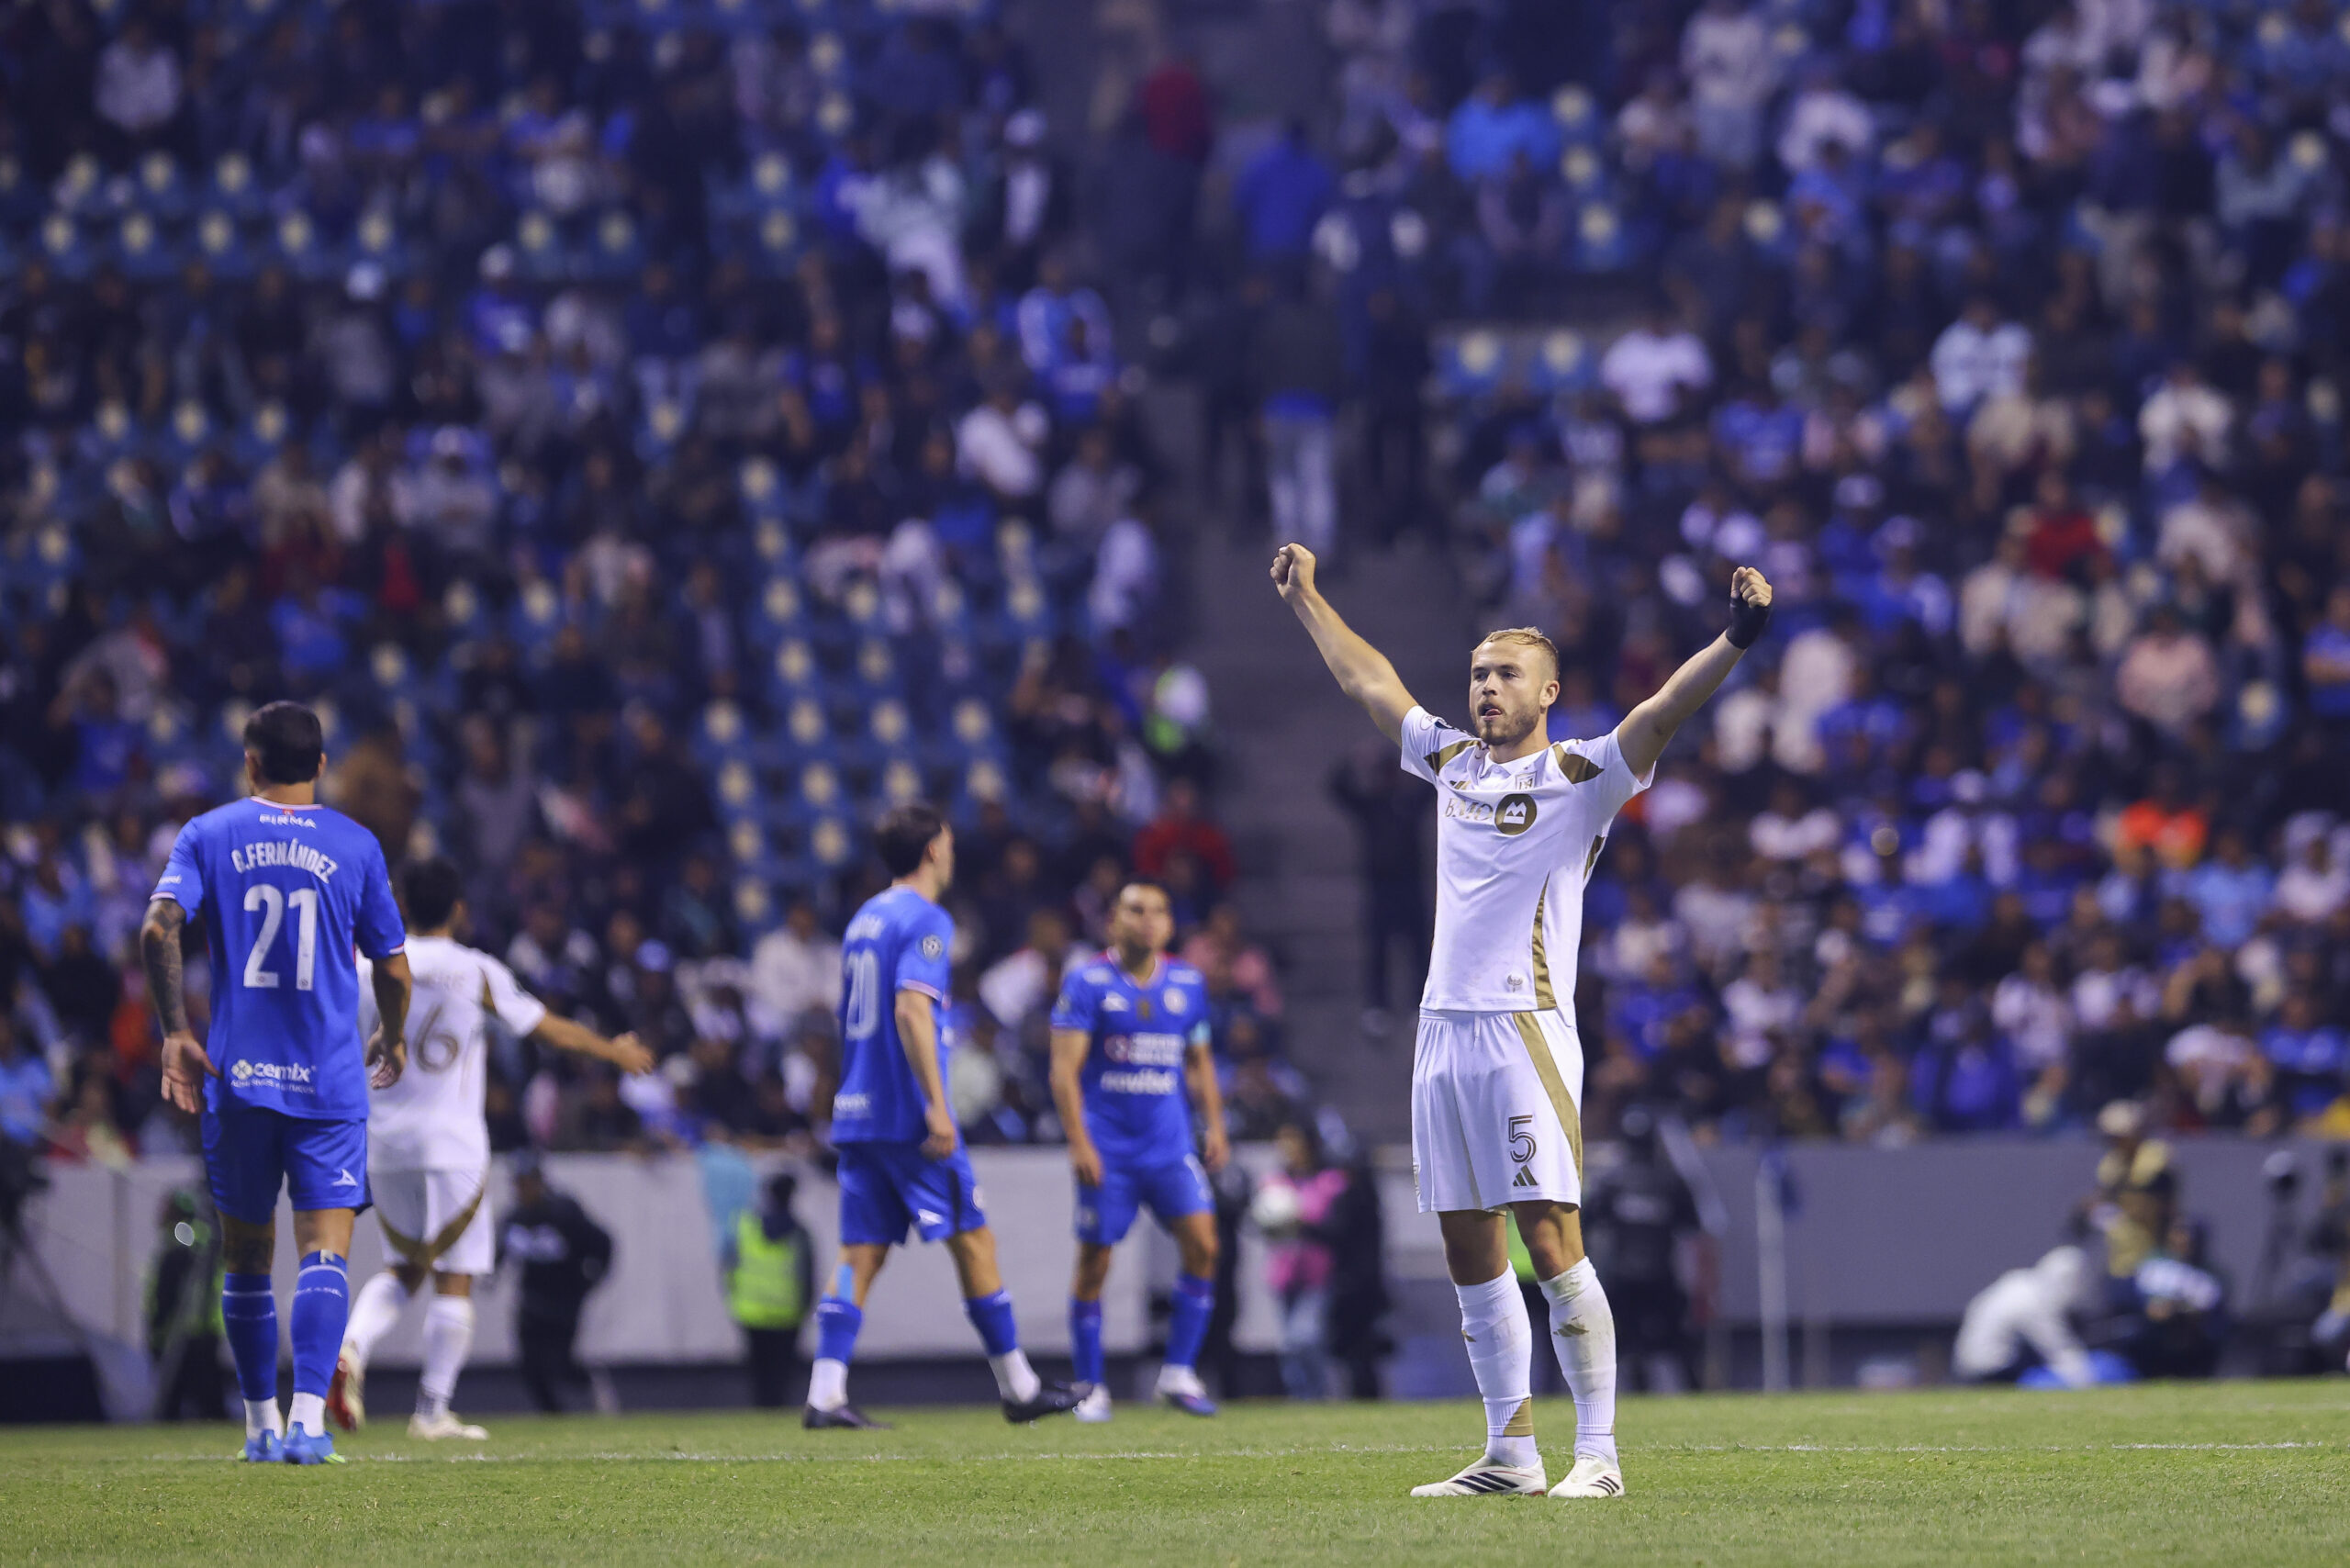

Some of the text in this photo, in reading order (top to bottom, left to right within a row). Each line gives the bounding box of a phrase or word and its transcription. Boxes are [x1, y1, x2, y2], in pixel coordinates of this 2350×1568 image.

[243, 883, 318, 991] 21
[253, 1062, 310, 1083] cemix
[1508, 1114, 1538, 1163] 5
